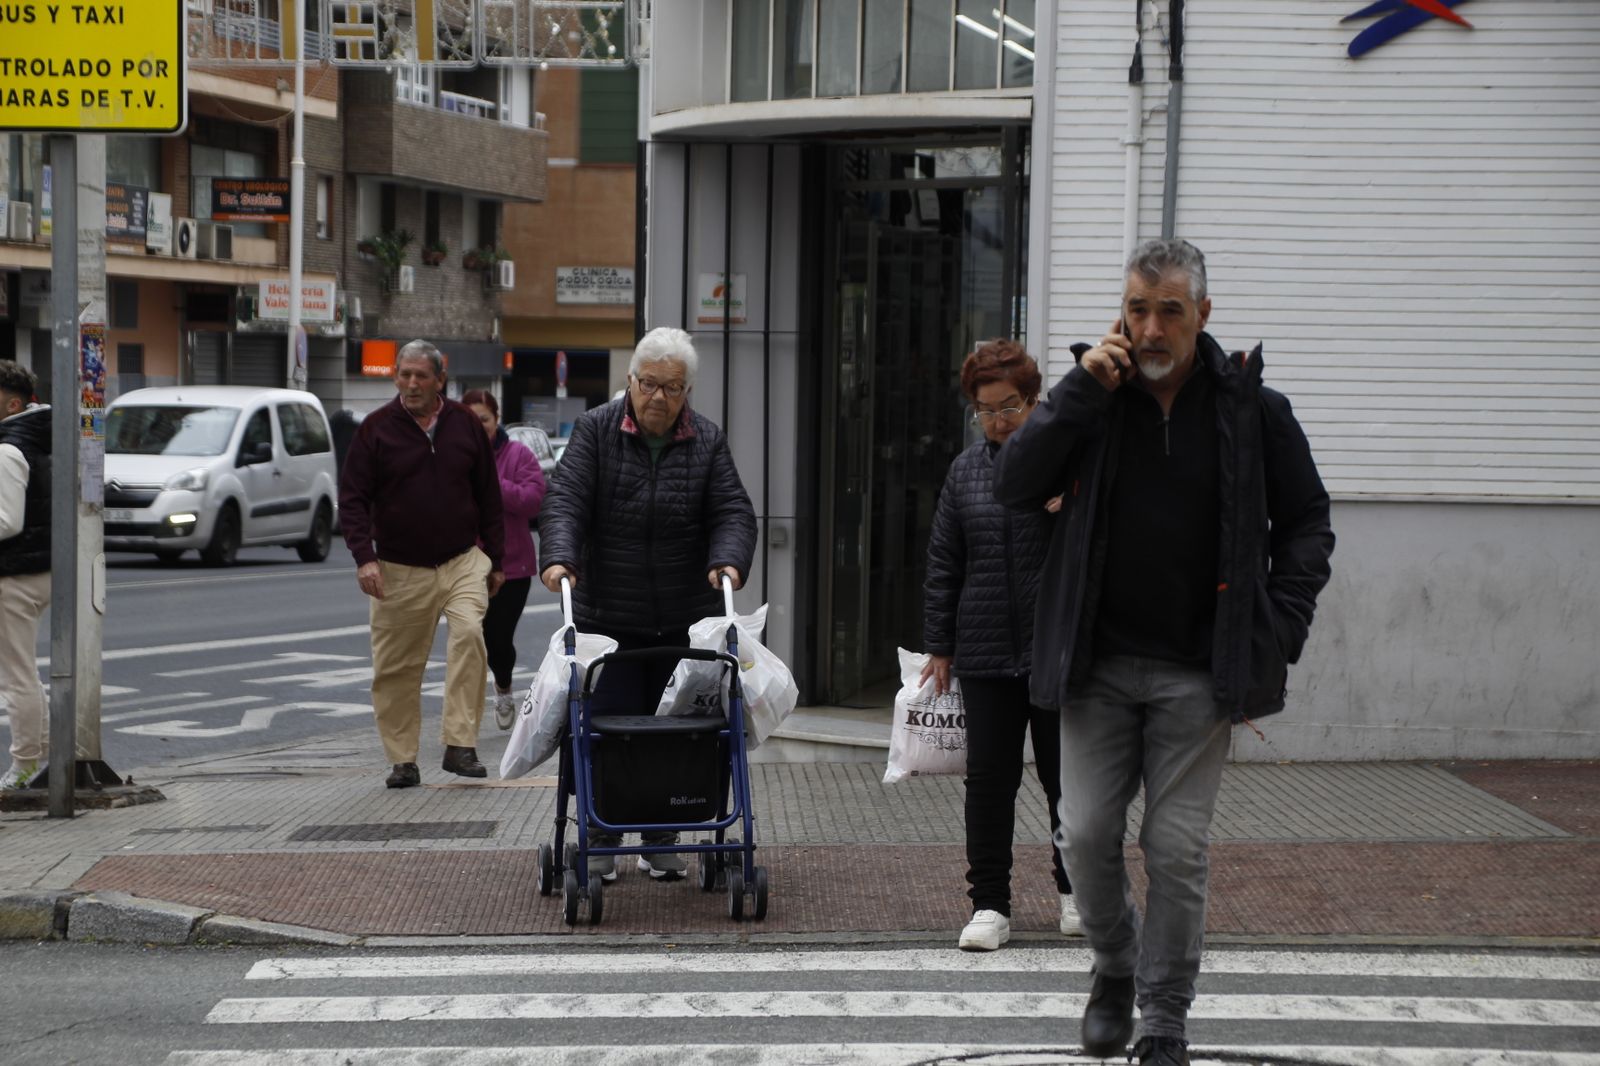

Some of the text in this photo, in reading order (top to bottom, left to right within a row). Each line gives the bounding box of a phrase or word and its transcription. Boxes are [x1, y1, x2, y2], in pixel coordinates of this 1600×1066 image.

[0, 5, 124, 24] US Y TAXI
[122, 59, 168, 78] POR
[0, 88, 164, 108] ARAS DE T.V.
[362, 365, 392, 375] orange
